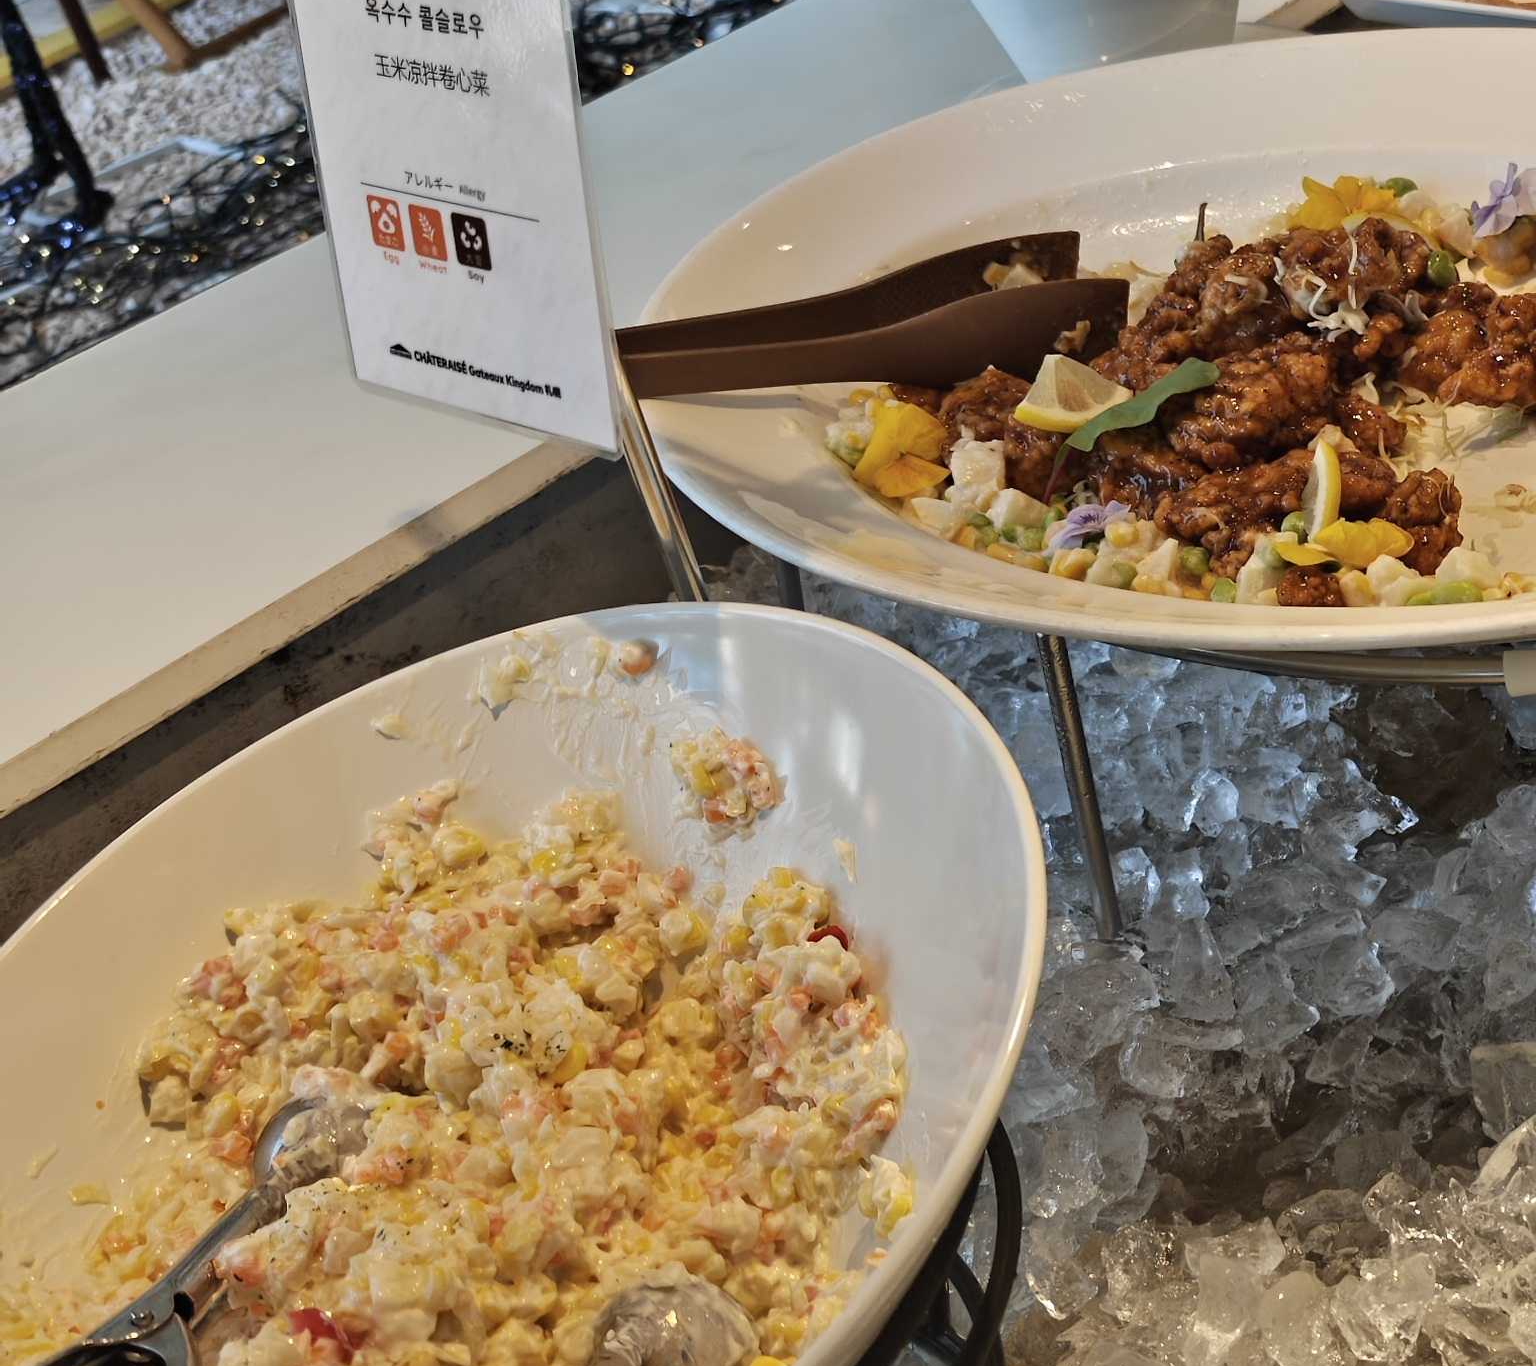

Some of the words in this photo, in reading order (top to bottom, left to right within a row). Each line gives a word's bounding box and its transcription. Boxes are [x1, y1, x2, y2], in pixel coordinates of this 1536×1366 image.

[419, 5, 484, 39] 콜슬로우
[374, 54, 490, 97] 玉米凉拌卷心菜
[404, 171, 453, 190] アレルギー
[468, 269, 484, 284] Soy
[414, 349, 467, 375] CHÂTERAISÉ
[468, 365, 505, 386] Gateaux
[506, 375, 543, 394] Kingdom
